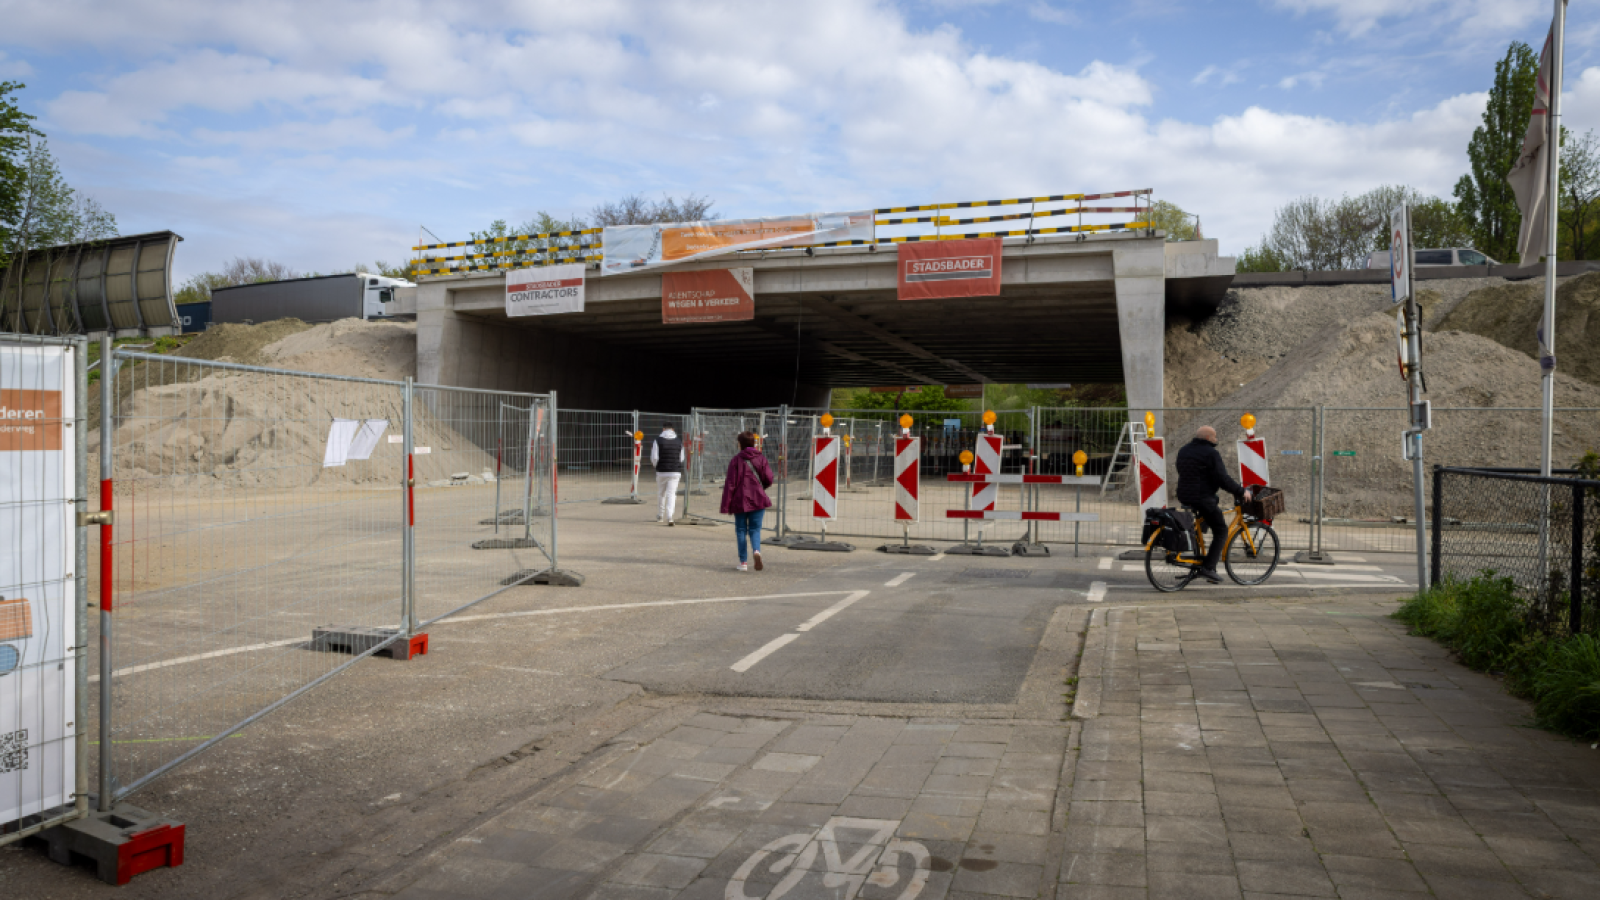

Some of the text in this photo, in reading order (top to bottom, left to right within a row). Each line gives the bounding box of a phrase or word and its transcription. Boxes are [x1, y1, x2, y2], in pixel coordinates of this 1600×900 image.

[912, 258, 985, 273] STADSBADER
[510, 287, 579, 302] CONTRACTORS
[668, 299, 697, 308] WEGEN
[705, 297, 739, 307] VERKEER
